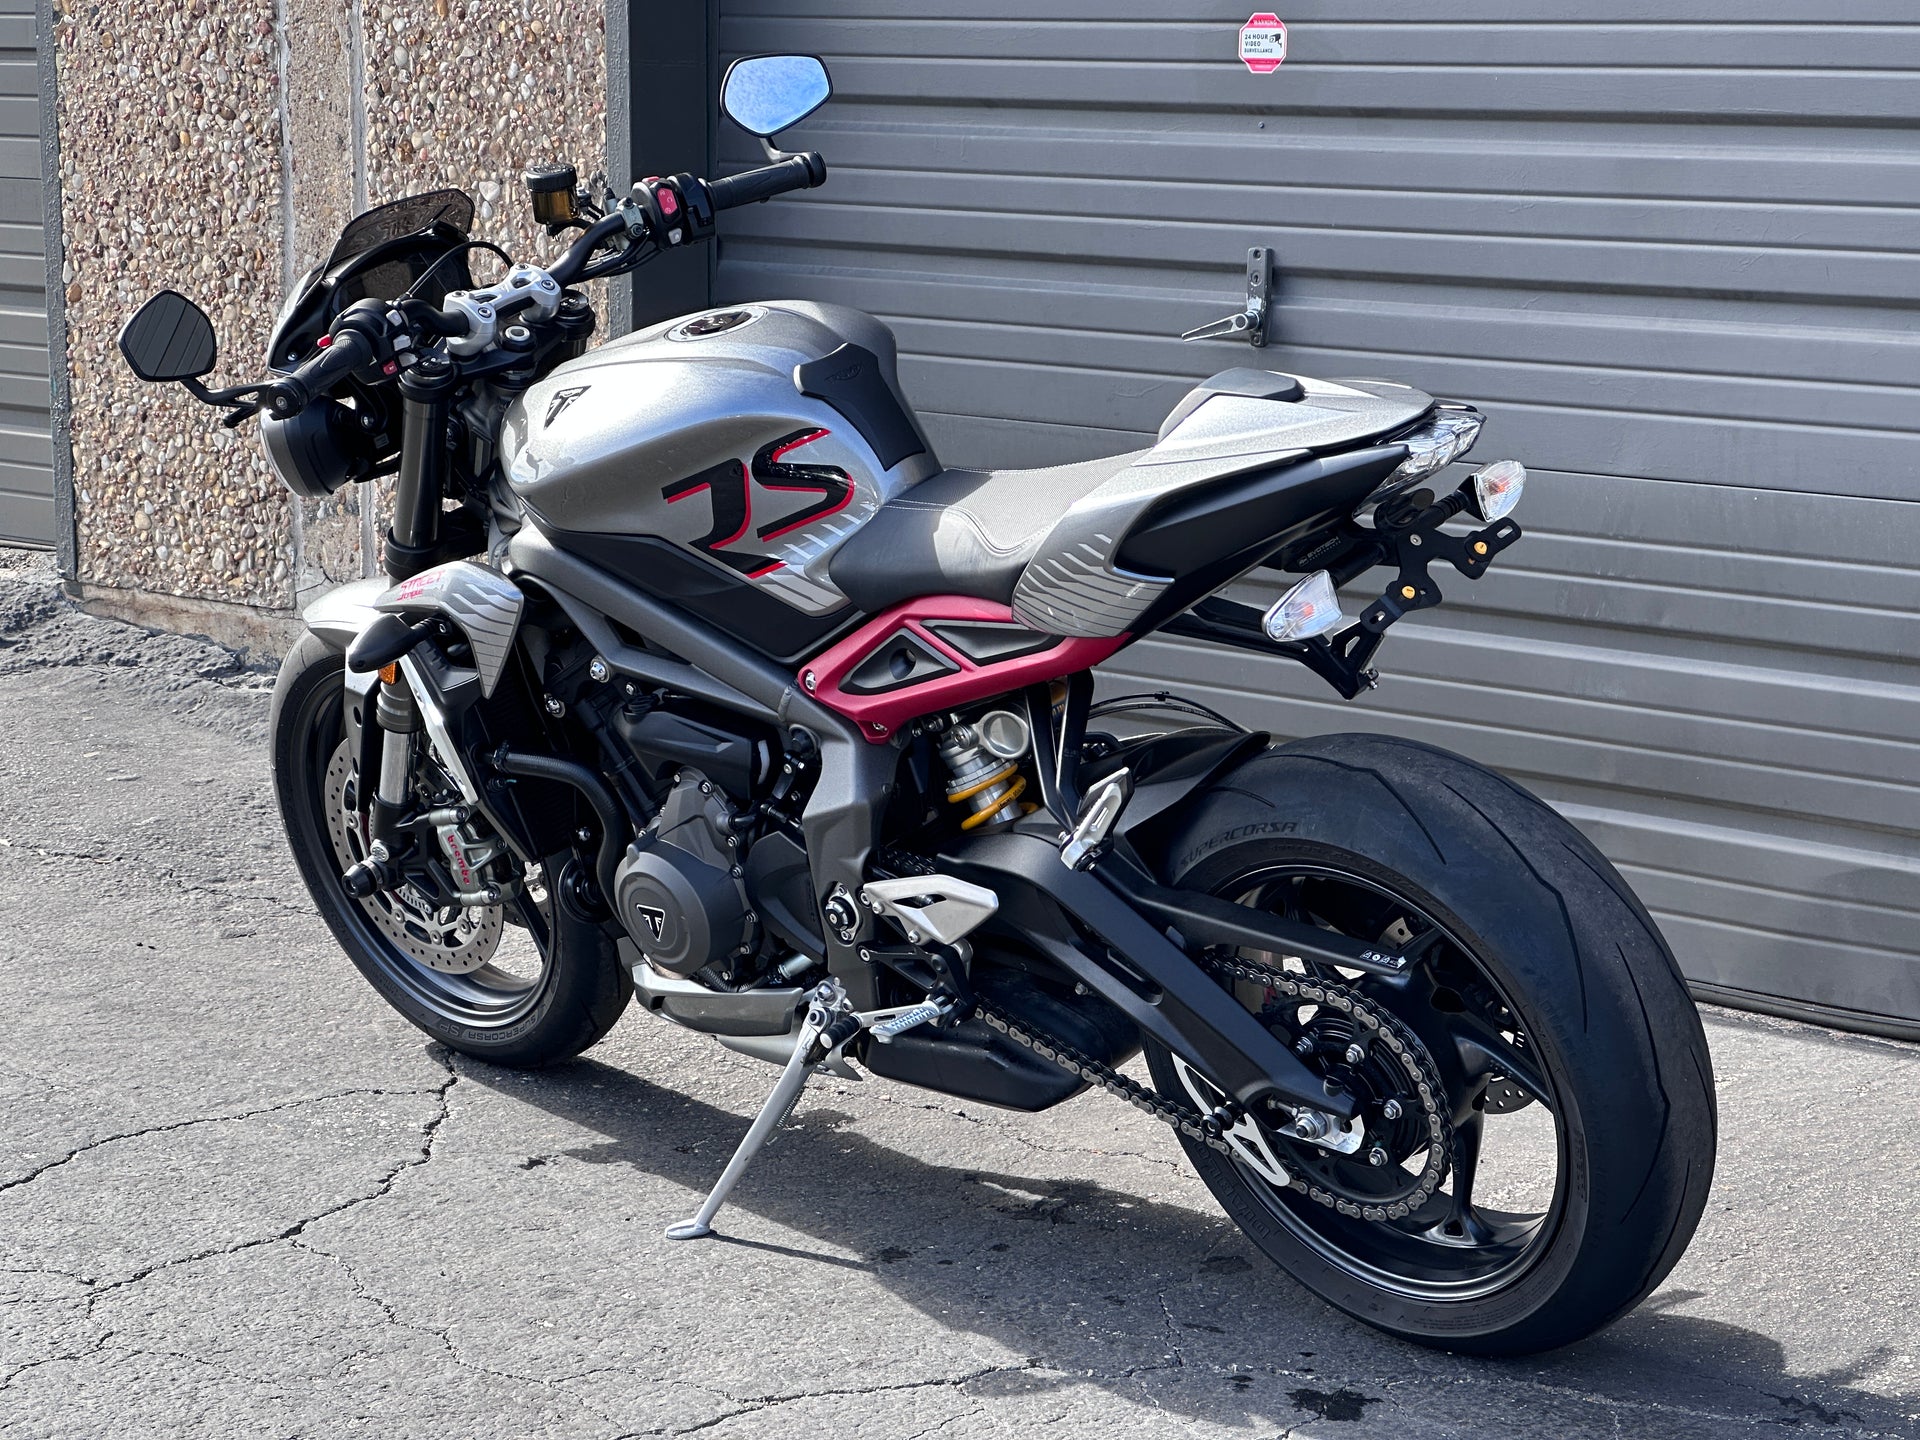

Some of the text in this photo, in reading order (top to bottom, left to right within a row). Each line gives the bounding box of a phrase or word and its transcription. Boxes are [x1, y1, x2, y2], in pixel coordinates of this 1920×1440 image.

[447, 834, 471, 885] brembo
[1180, 821, 1298, 868] SUPERCORSA
[439, 1013, 537, 1041] SUPERCORSA SP
